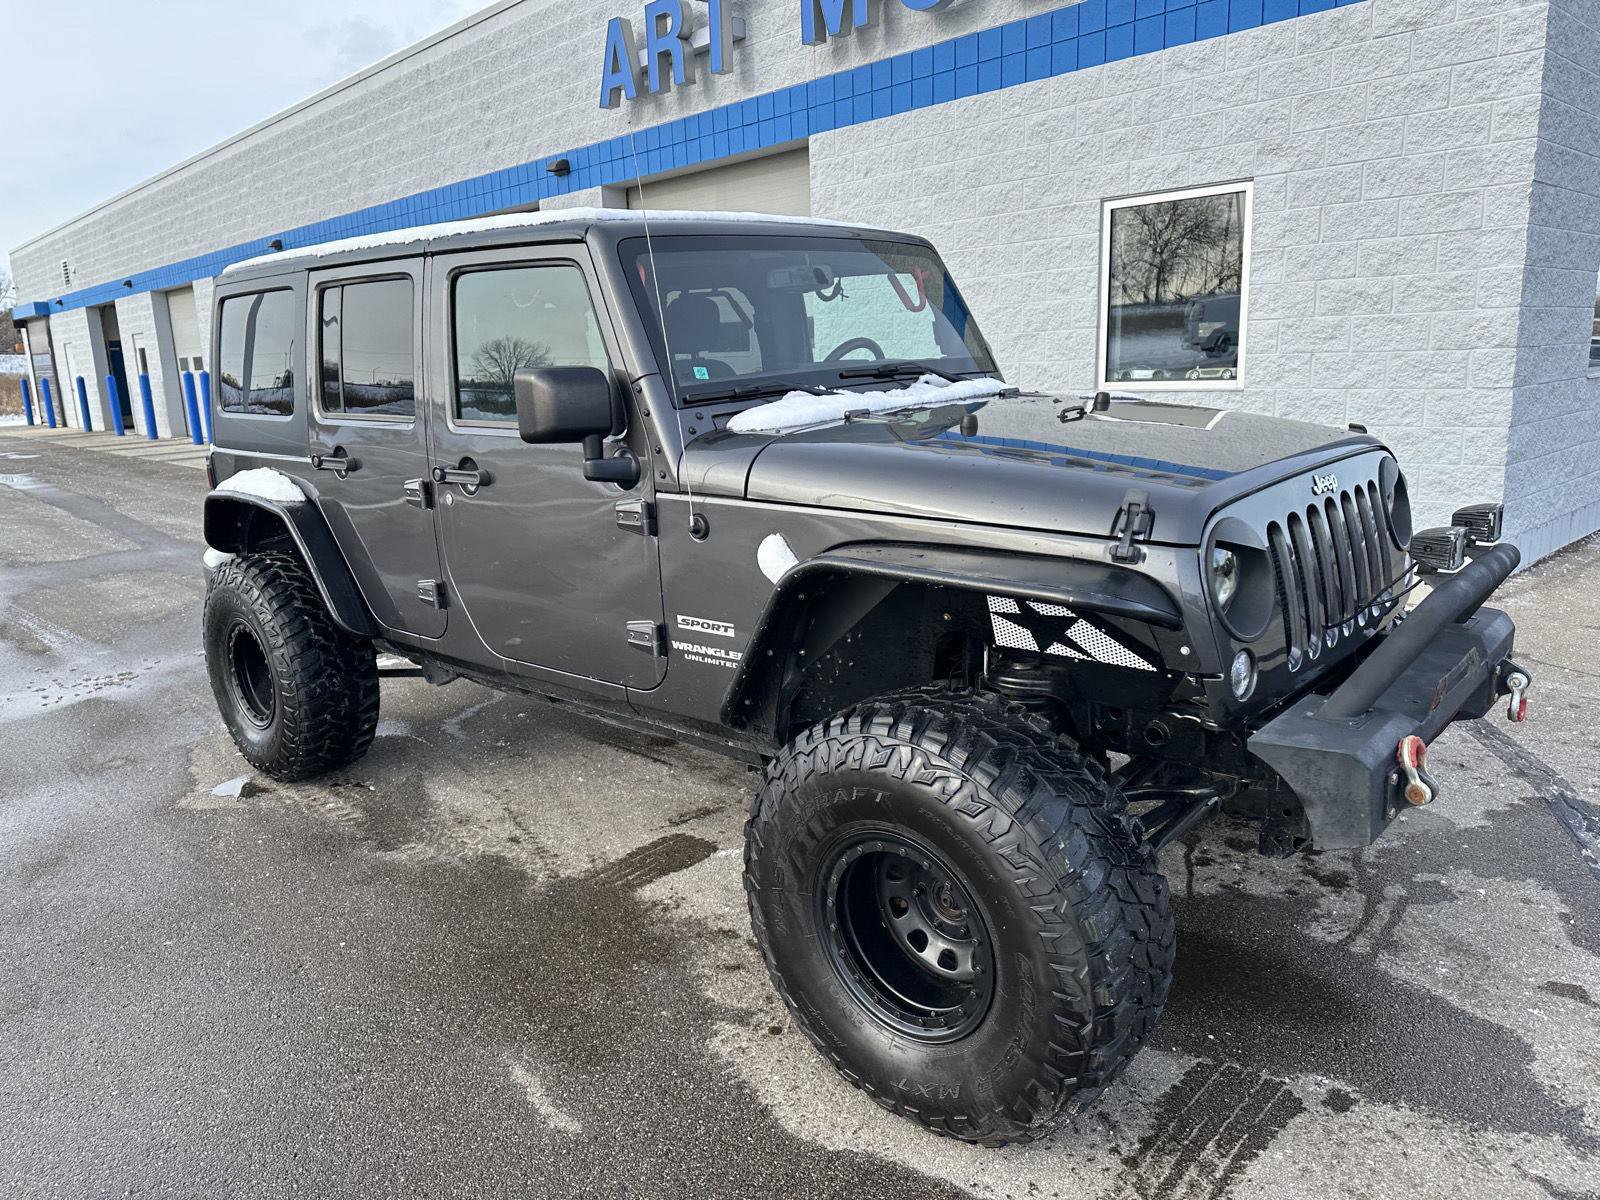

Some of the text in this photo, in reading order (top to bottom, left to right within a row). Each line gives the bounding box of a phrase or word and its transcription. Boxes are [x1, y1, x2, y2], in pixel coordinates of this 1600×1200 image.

[1311, 473, 1338, 495] Jeep
[680, 617, 731, 633] SPORT
[684, 653, 739, 669] UNLIMITED
